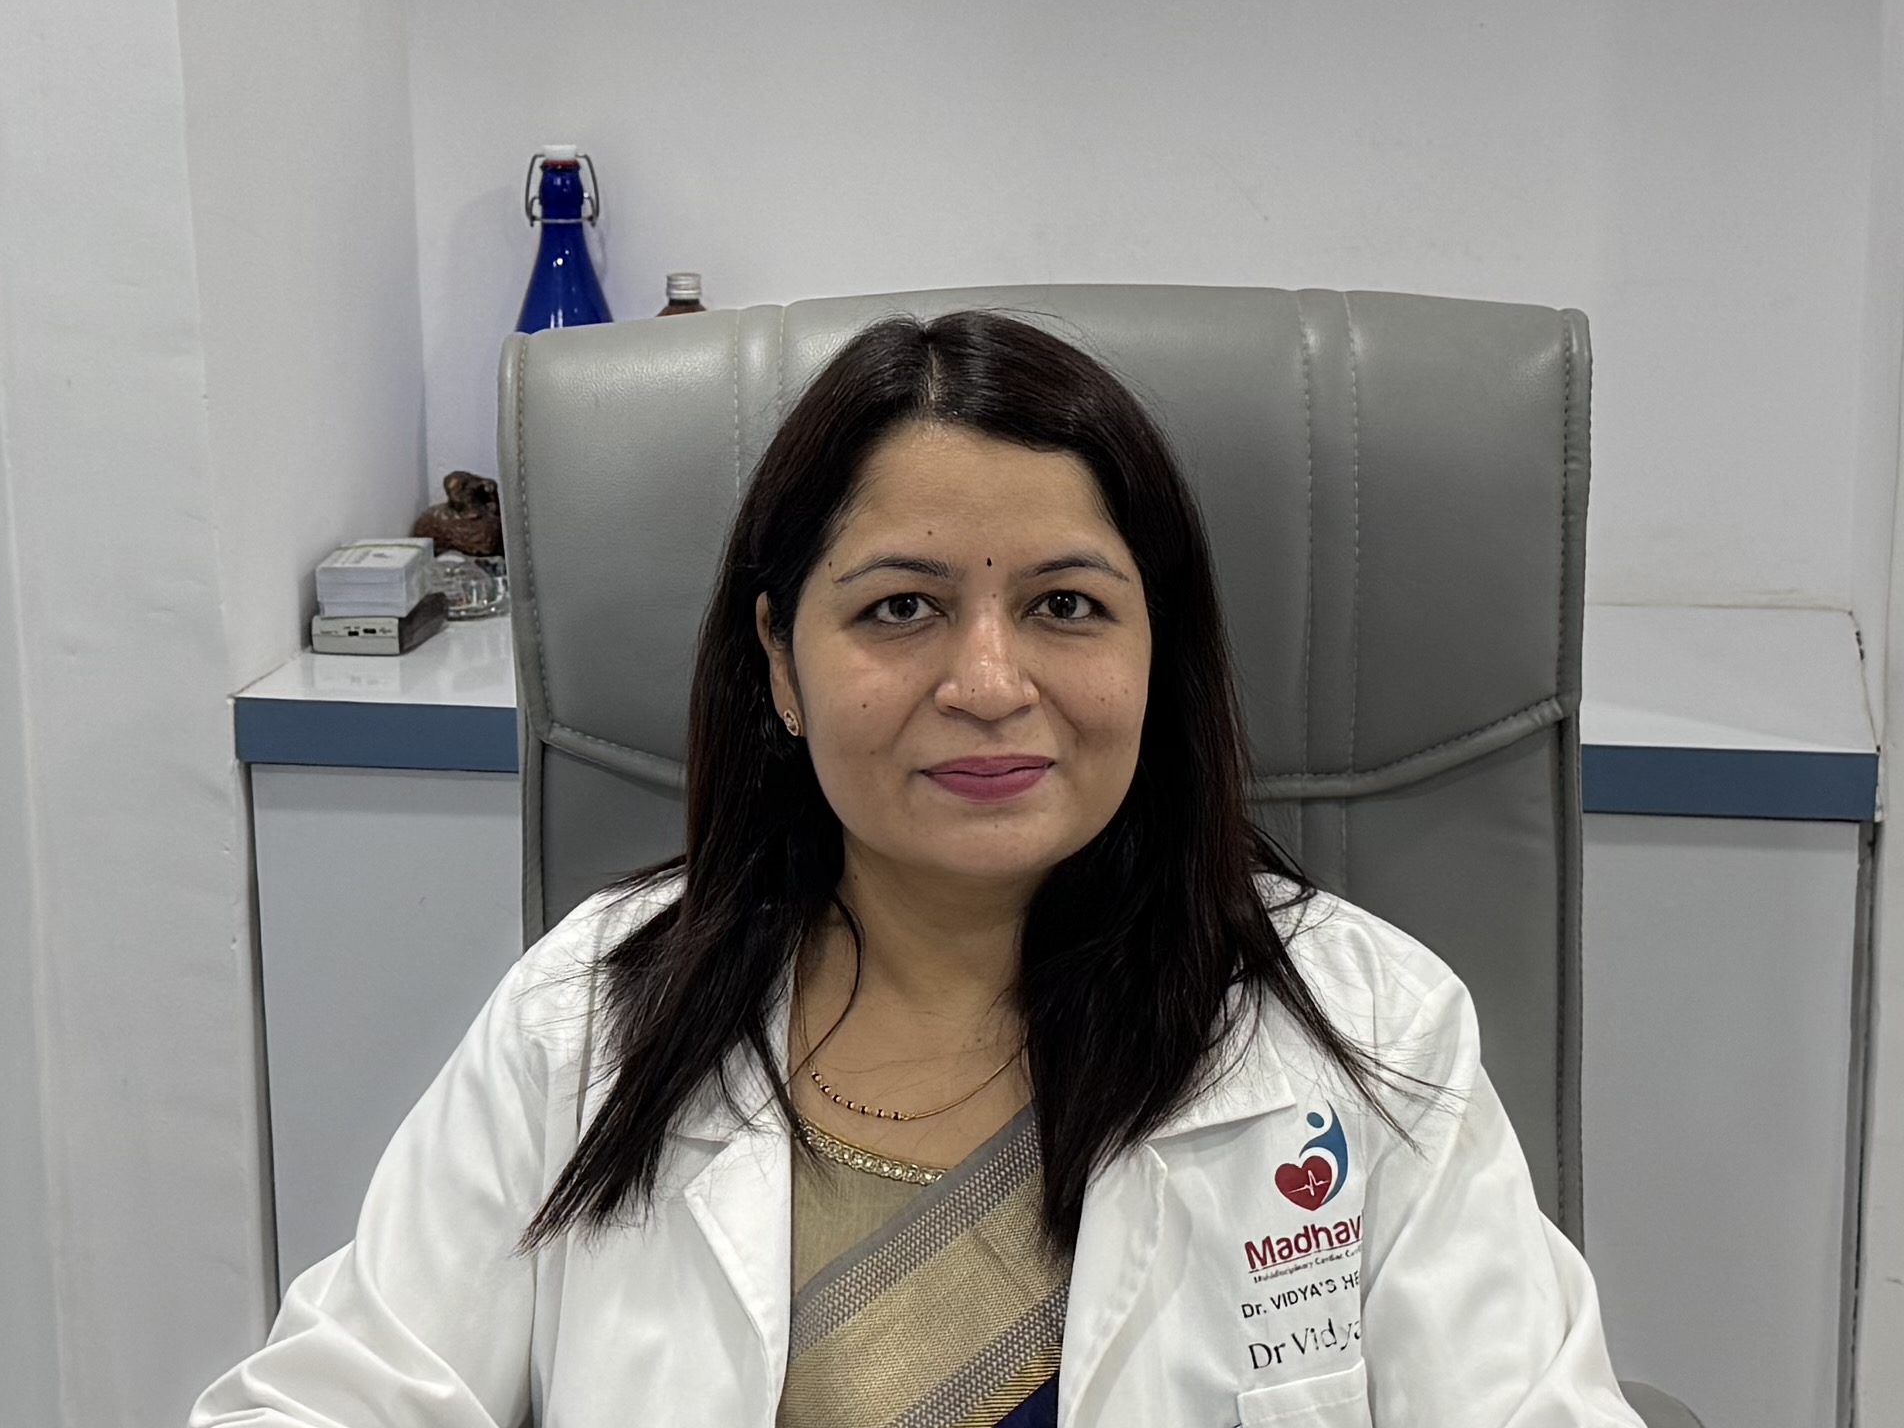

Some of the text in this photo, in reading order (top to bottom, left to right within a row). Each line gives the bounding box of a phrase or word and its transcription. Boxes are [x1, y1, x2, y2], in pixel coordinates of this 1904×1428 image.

[1241, 1303, 1268, 1319] Dr.
[1270, 1278, 1338, 1310] VIDYA'S
[1248, 1342, 1286, 1370] Dr
